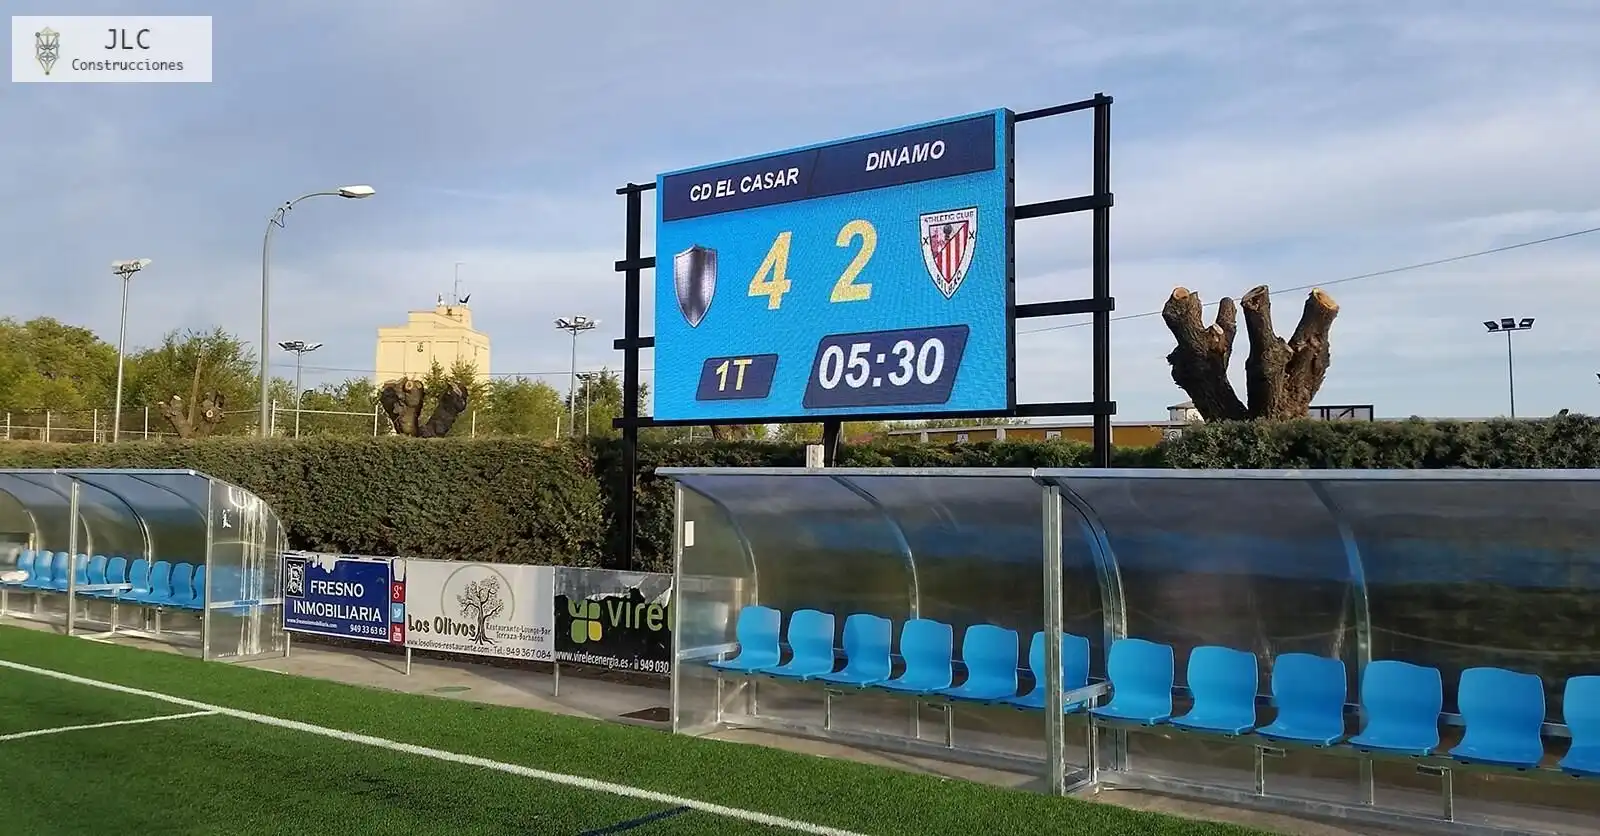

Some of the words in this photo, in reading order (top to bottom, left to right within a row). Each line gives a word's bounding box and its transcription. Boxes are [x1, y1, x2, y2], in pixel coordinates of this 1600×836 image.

[865, 140, 945, 171] DINAMO
[690, 183, 712, 202] CD
[715, 179, 735, 198] EL
[740, 167, 799, 192] CASAR
[748, 231, 792, 310] 4
[830, 219, 877, 303] 2
[715, 358, 752, 391] 1T
[818, 337, 945, 390] 05:30
[310, 580, 364, 598] FRESNO
[293, 600, 382, 623] INMOBILIARIA
[349, 623, 361, 633] 949
[361, 625, 370, 634] 33
[370, 626, 378, 635] 63
[378, 627, 387, 636] 63
[408, 614, 430, 633] Los
[434, 616, 477, 637] Olivos
[506, 647, 520, 656] 949
[521, 648, 535, 657] 367
[536, 650, 551, 659] 084
[555, 650, 628, 668] www.virelecenergia.es
[640, 659, 654, 671] 949
